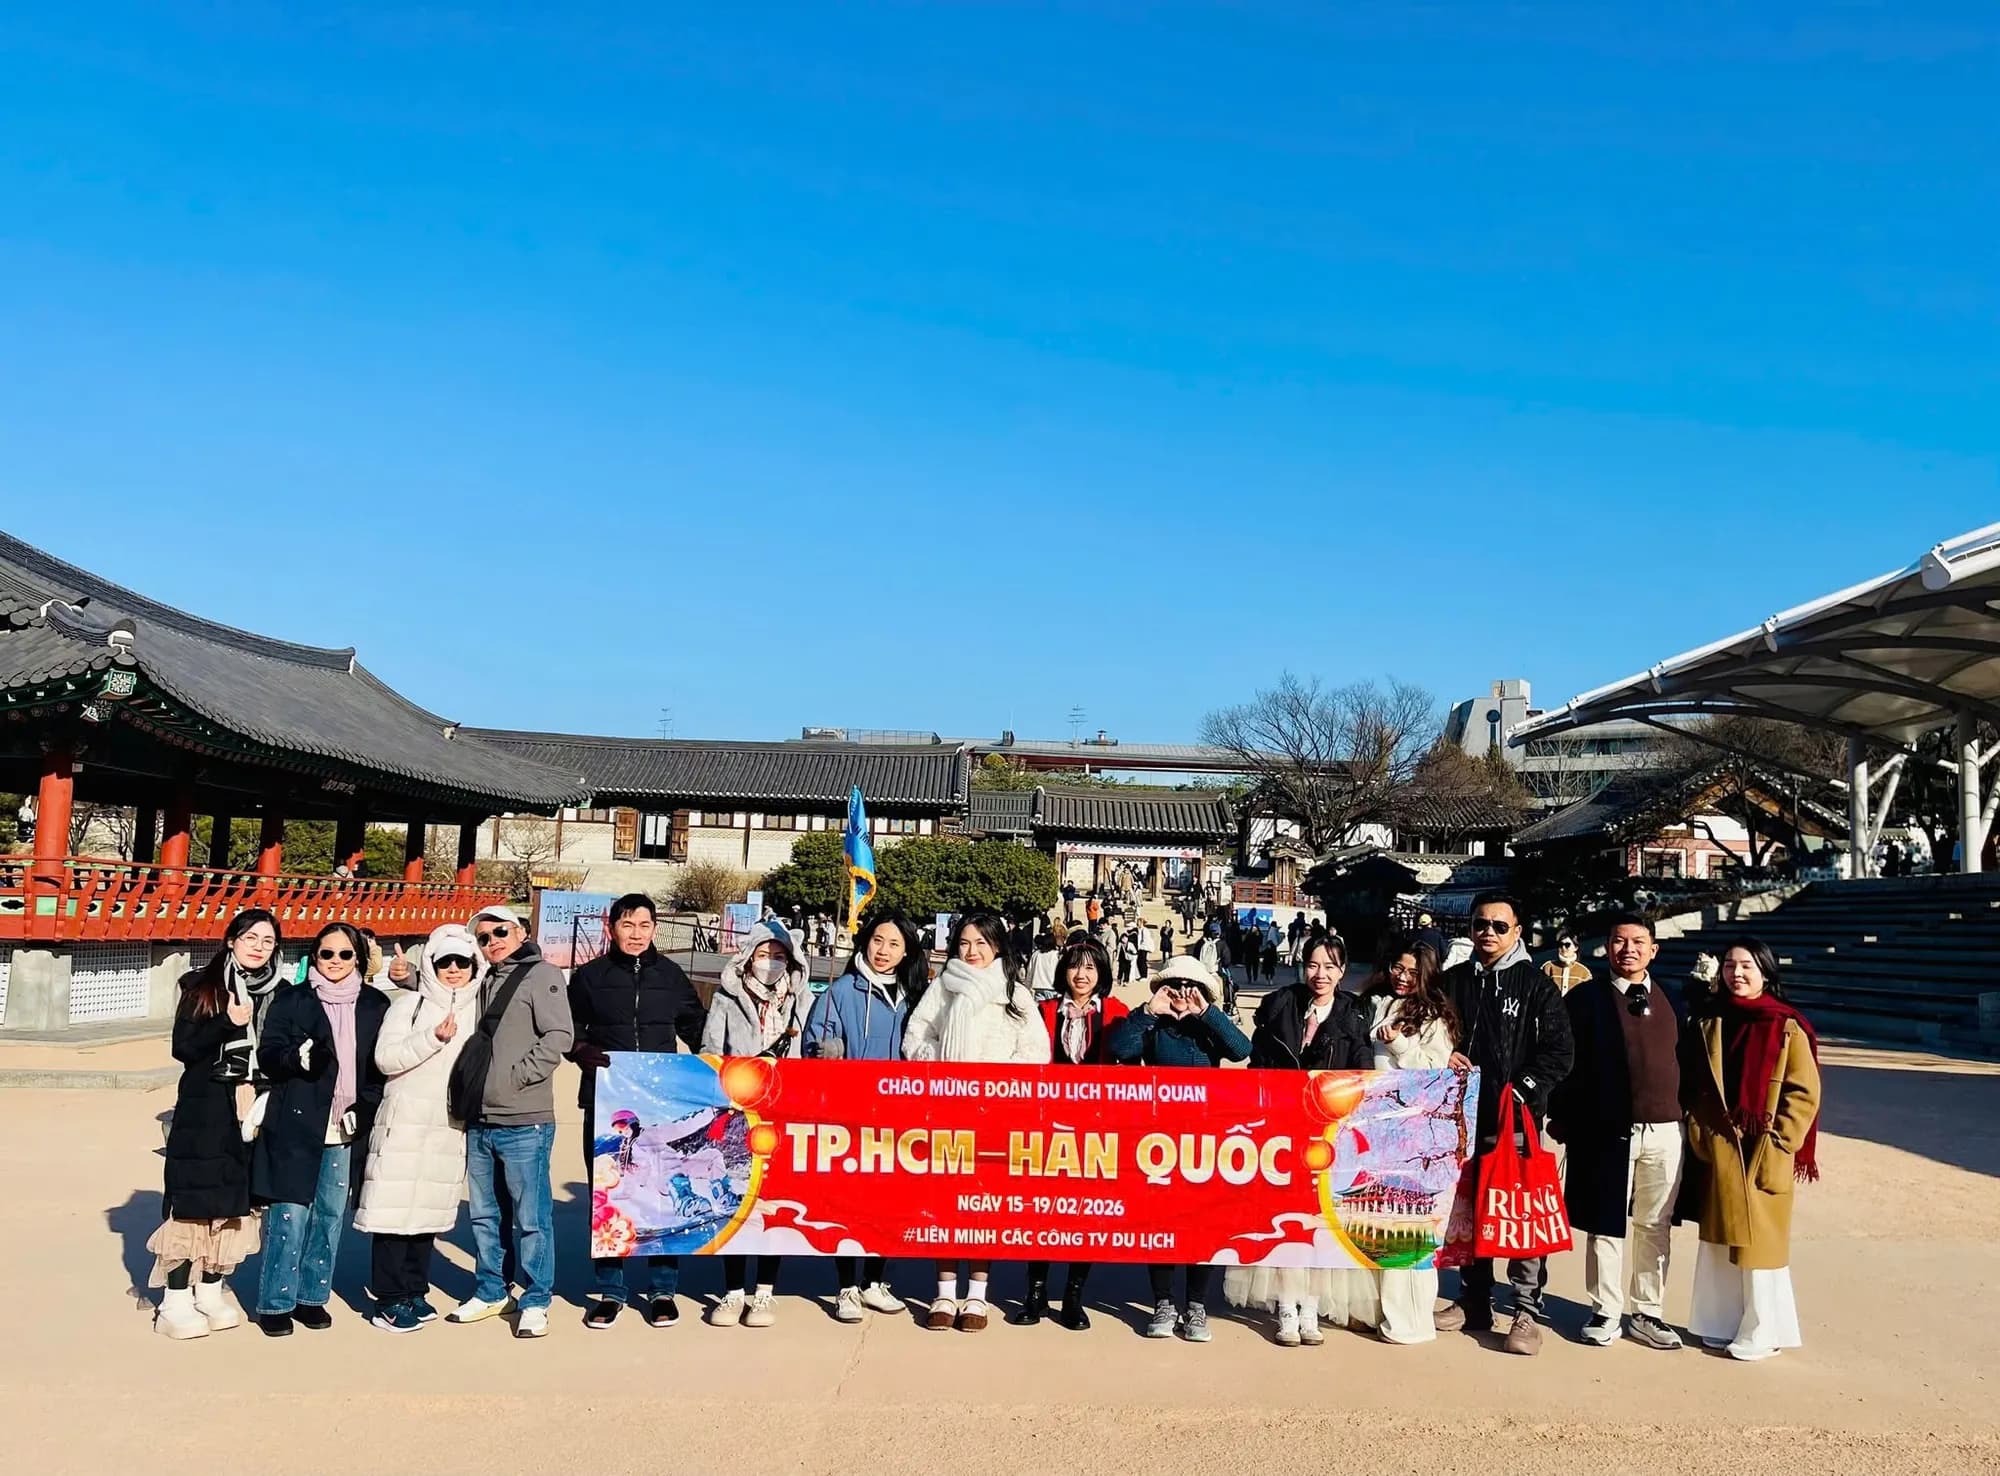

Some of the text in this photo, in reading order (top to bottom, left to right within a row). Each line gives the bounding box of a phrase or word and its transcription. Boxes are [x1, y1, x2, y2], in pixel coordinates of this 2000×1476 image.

[878, 1075, 1206, 1102] CHÀO MỪNG ĐOÀN DU LỊCH THAM QUAN
[1136, 1118, 1292, 1186] QUỐC
[957, 1192, 1002, 1212] NGÀY
[903, 1225, 1175, 1250] #LIÊN MINH CÁC CÔNG TY DU LỊCH
